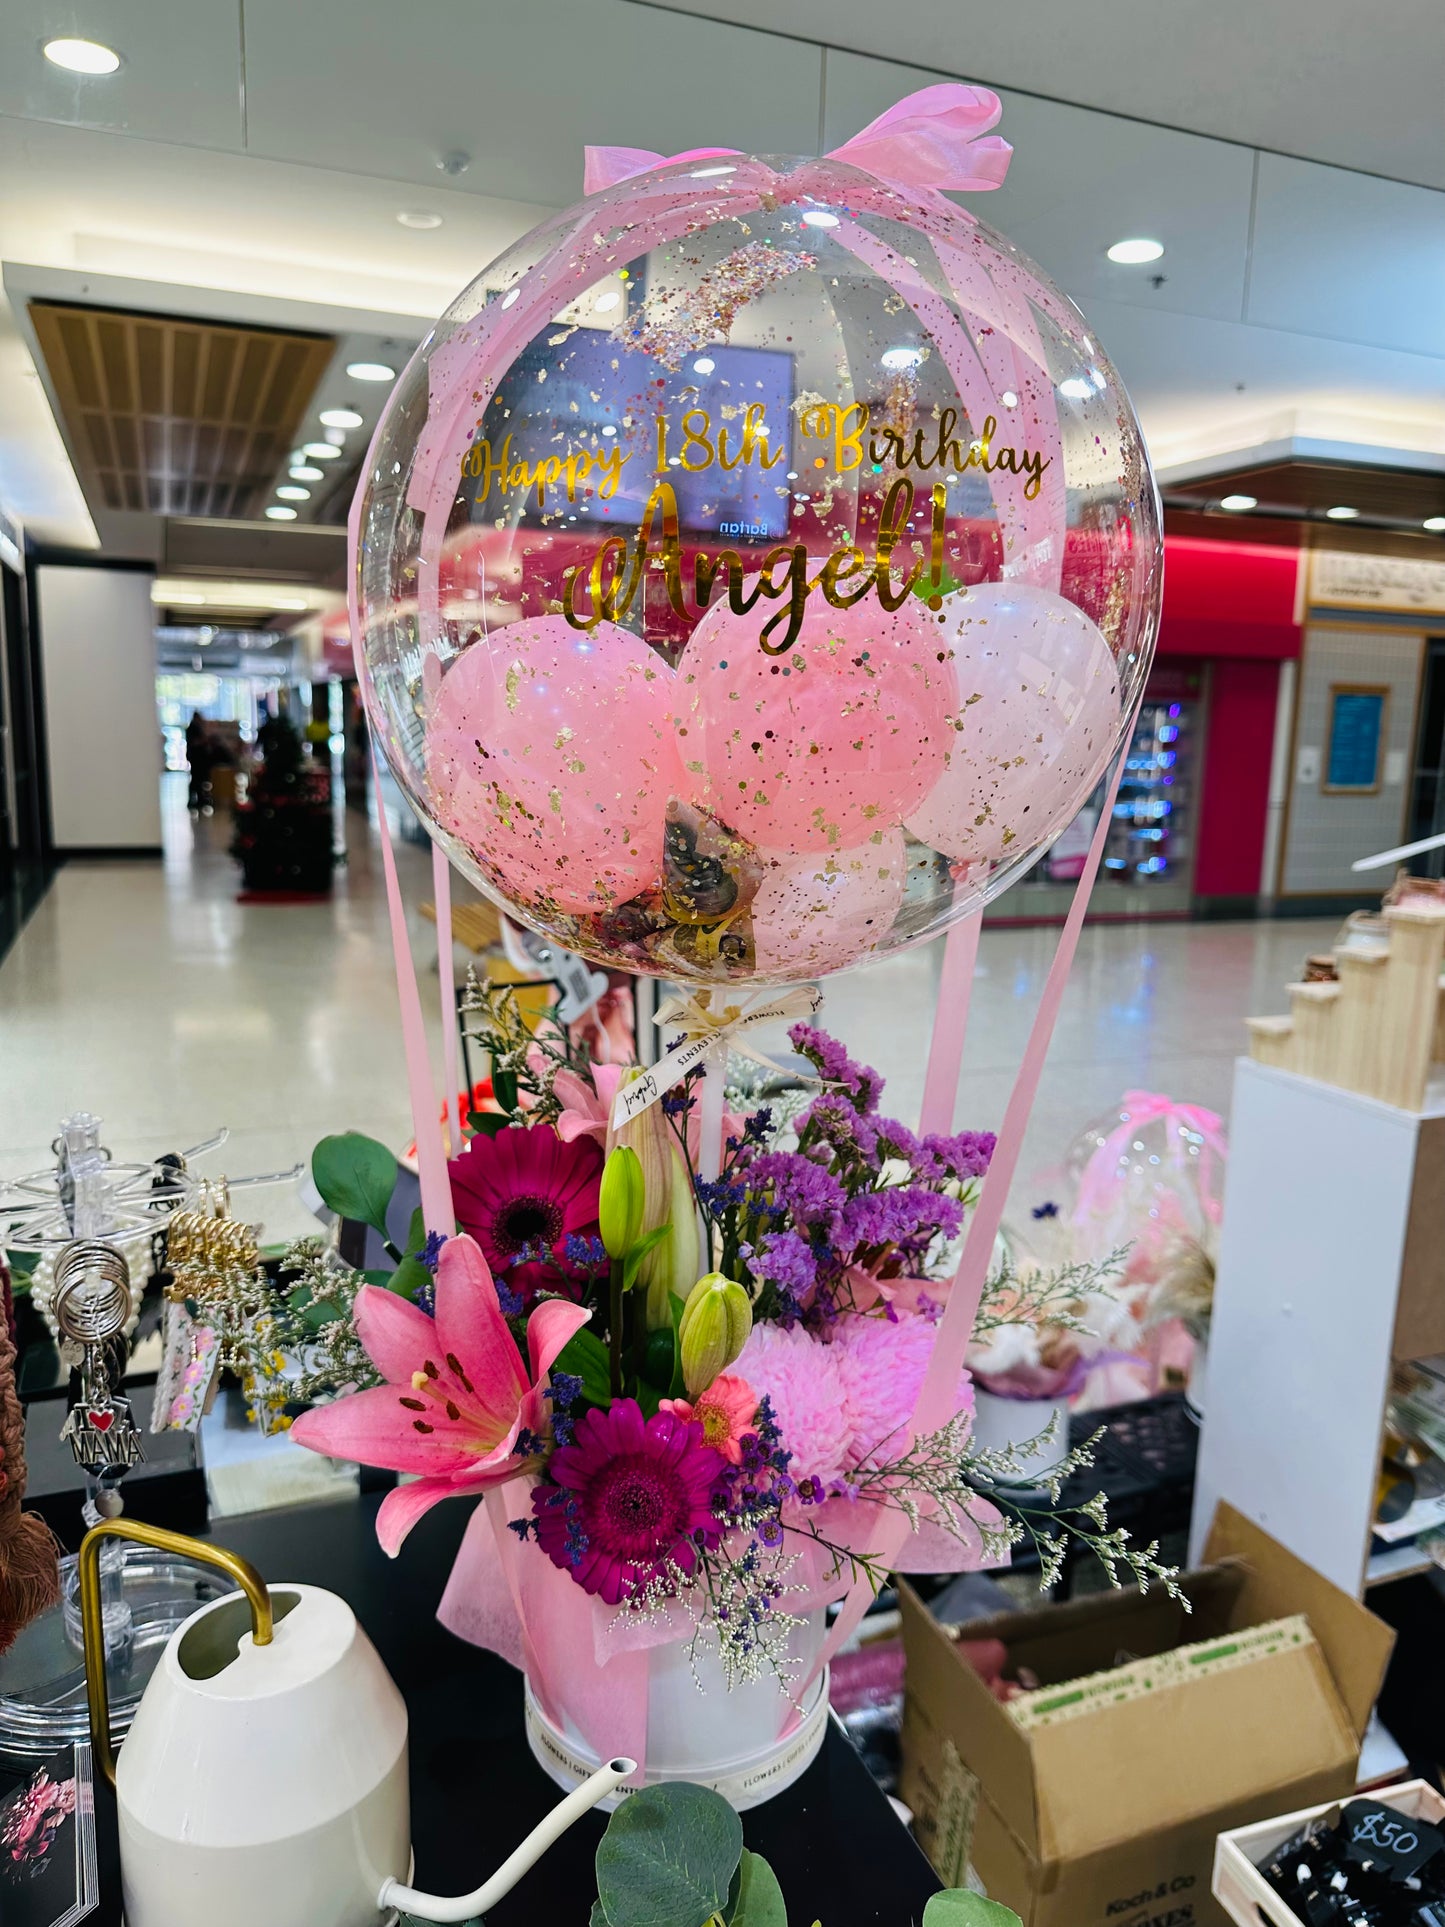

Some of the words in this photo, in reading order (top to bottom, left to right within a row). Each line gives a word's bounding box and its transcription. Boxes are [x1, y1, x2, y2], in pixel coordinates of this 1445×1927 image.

[461, 432, 633, 506] Happy
[656, 403, 784, 473] 18th
[800, 402, 1052, 501] Birthday
[564, 478, 946, 656] Angel!
[677, 1040, 709, 1066] EVENTS
[75, 1403, 95, 1432] I
[69, 1431, 148, 1464] MAMA
[743, 1763, 782, 1788] FLOWERS
[1353, 1811, 1419, 1854] $50
[1170, 1875, 1196, 1893] Co
